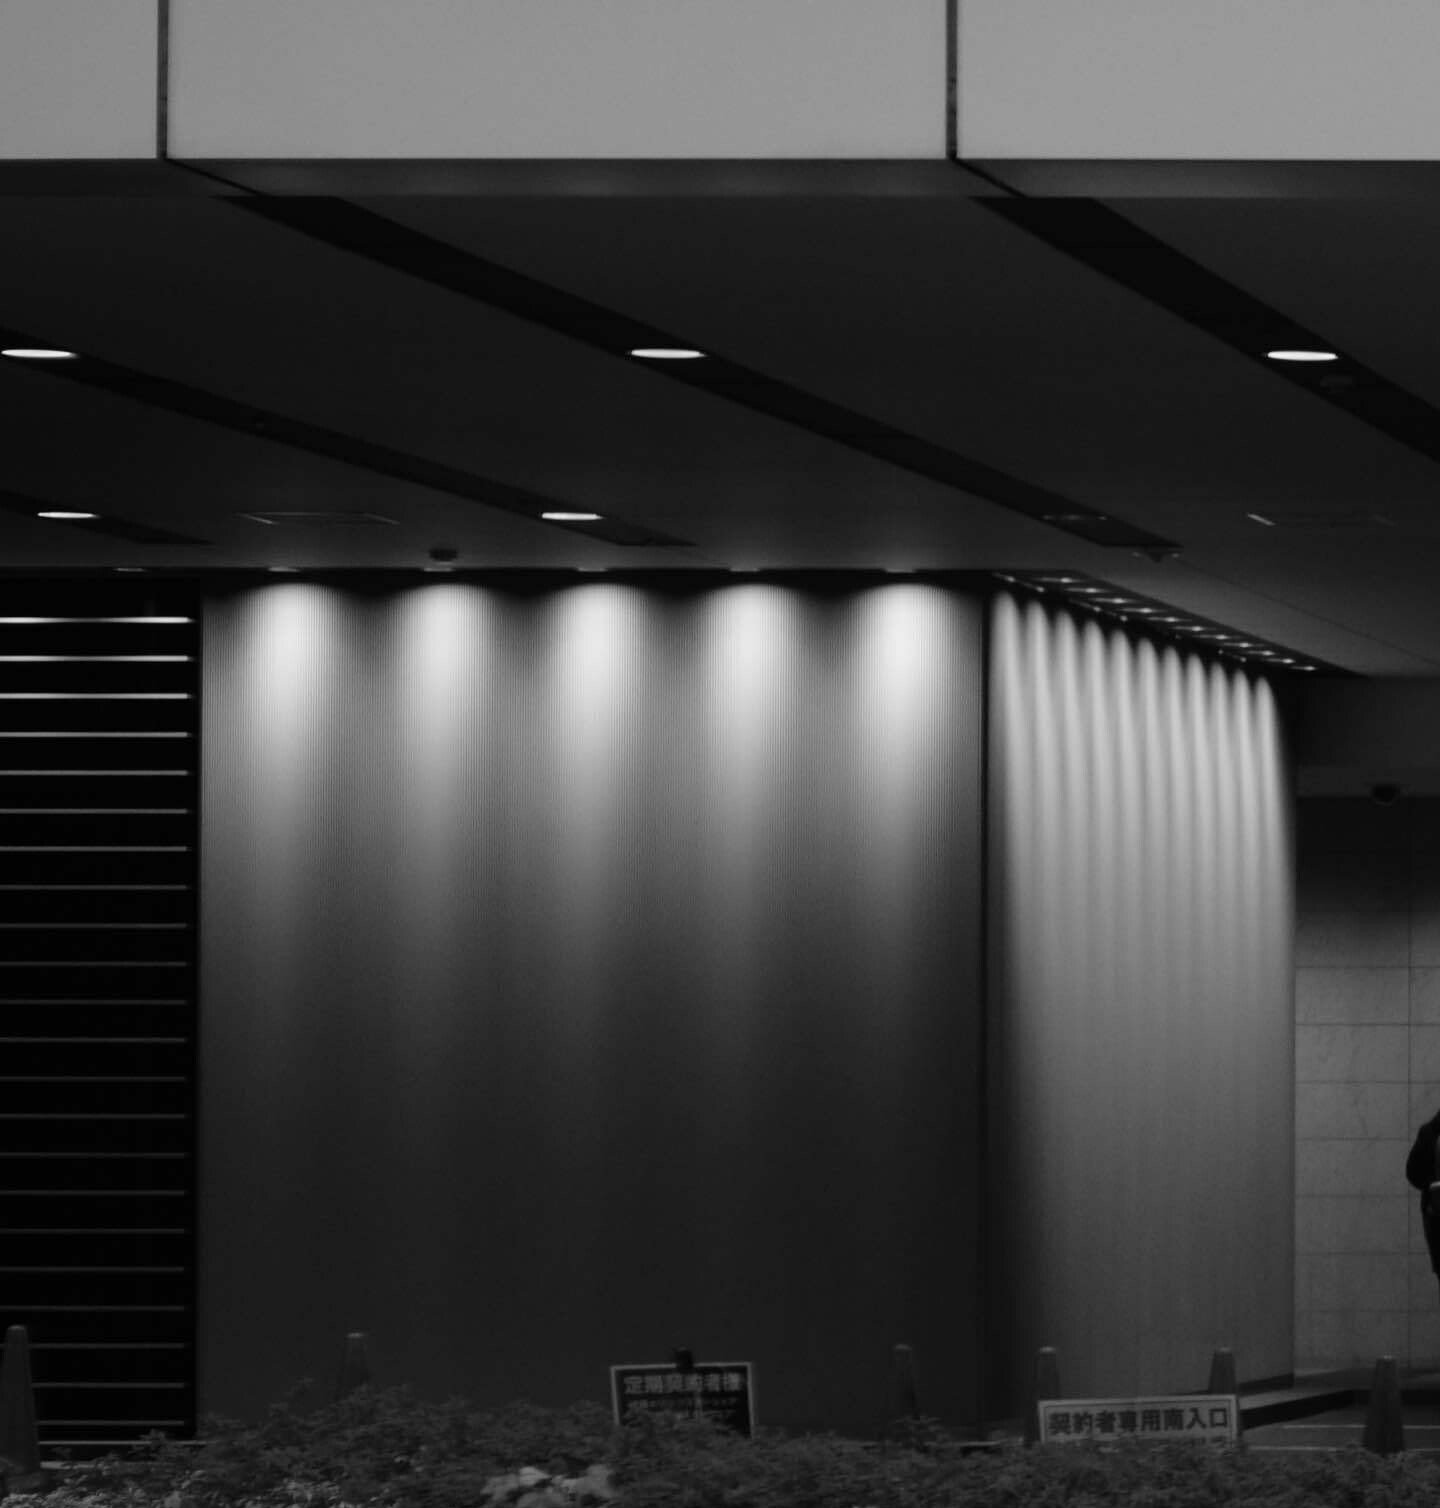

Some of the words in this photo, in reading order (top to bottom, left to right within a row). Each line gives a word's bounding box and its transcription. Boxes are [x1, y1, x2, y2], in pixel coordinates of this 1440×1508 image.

[1049, 1407, 1228, 1435] 契約者専用南入口
